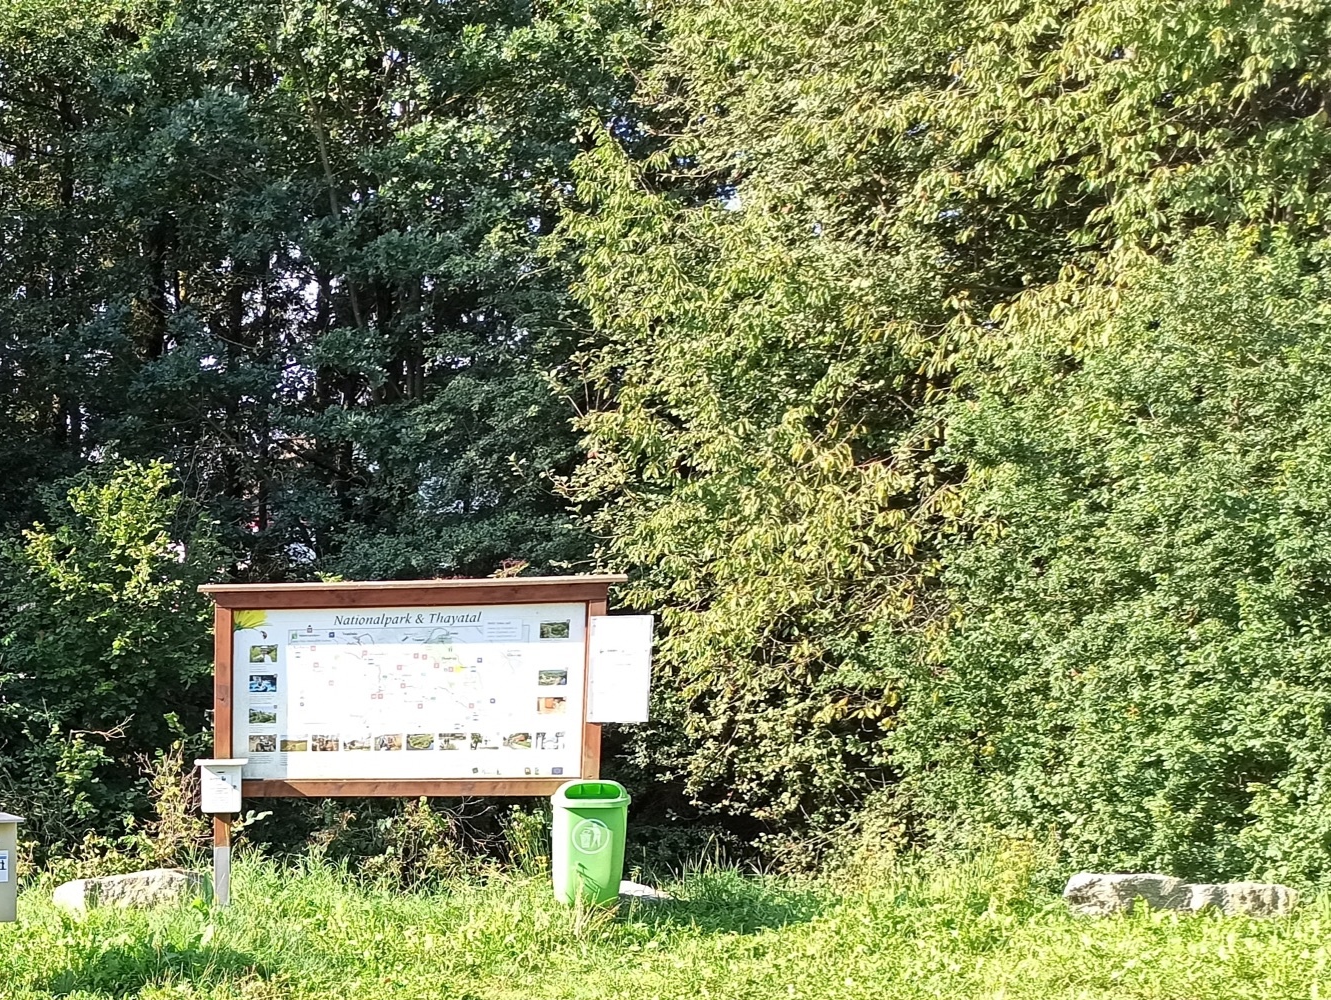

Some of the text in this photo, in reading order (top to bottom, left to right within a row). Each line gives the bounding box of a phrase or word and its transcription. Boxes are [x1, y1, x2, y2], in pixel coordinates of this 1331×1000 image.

[334, 611, 482, 627] Nationalpark & Thayatal
